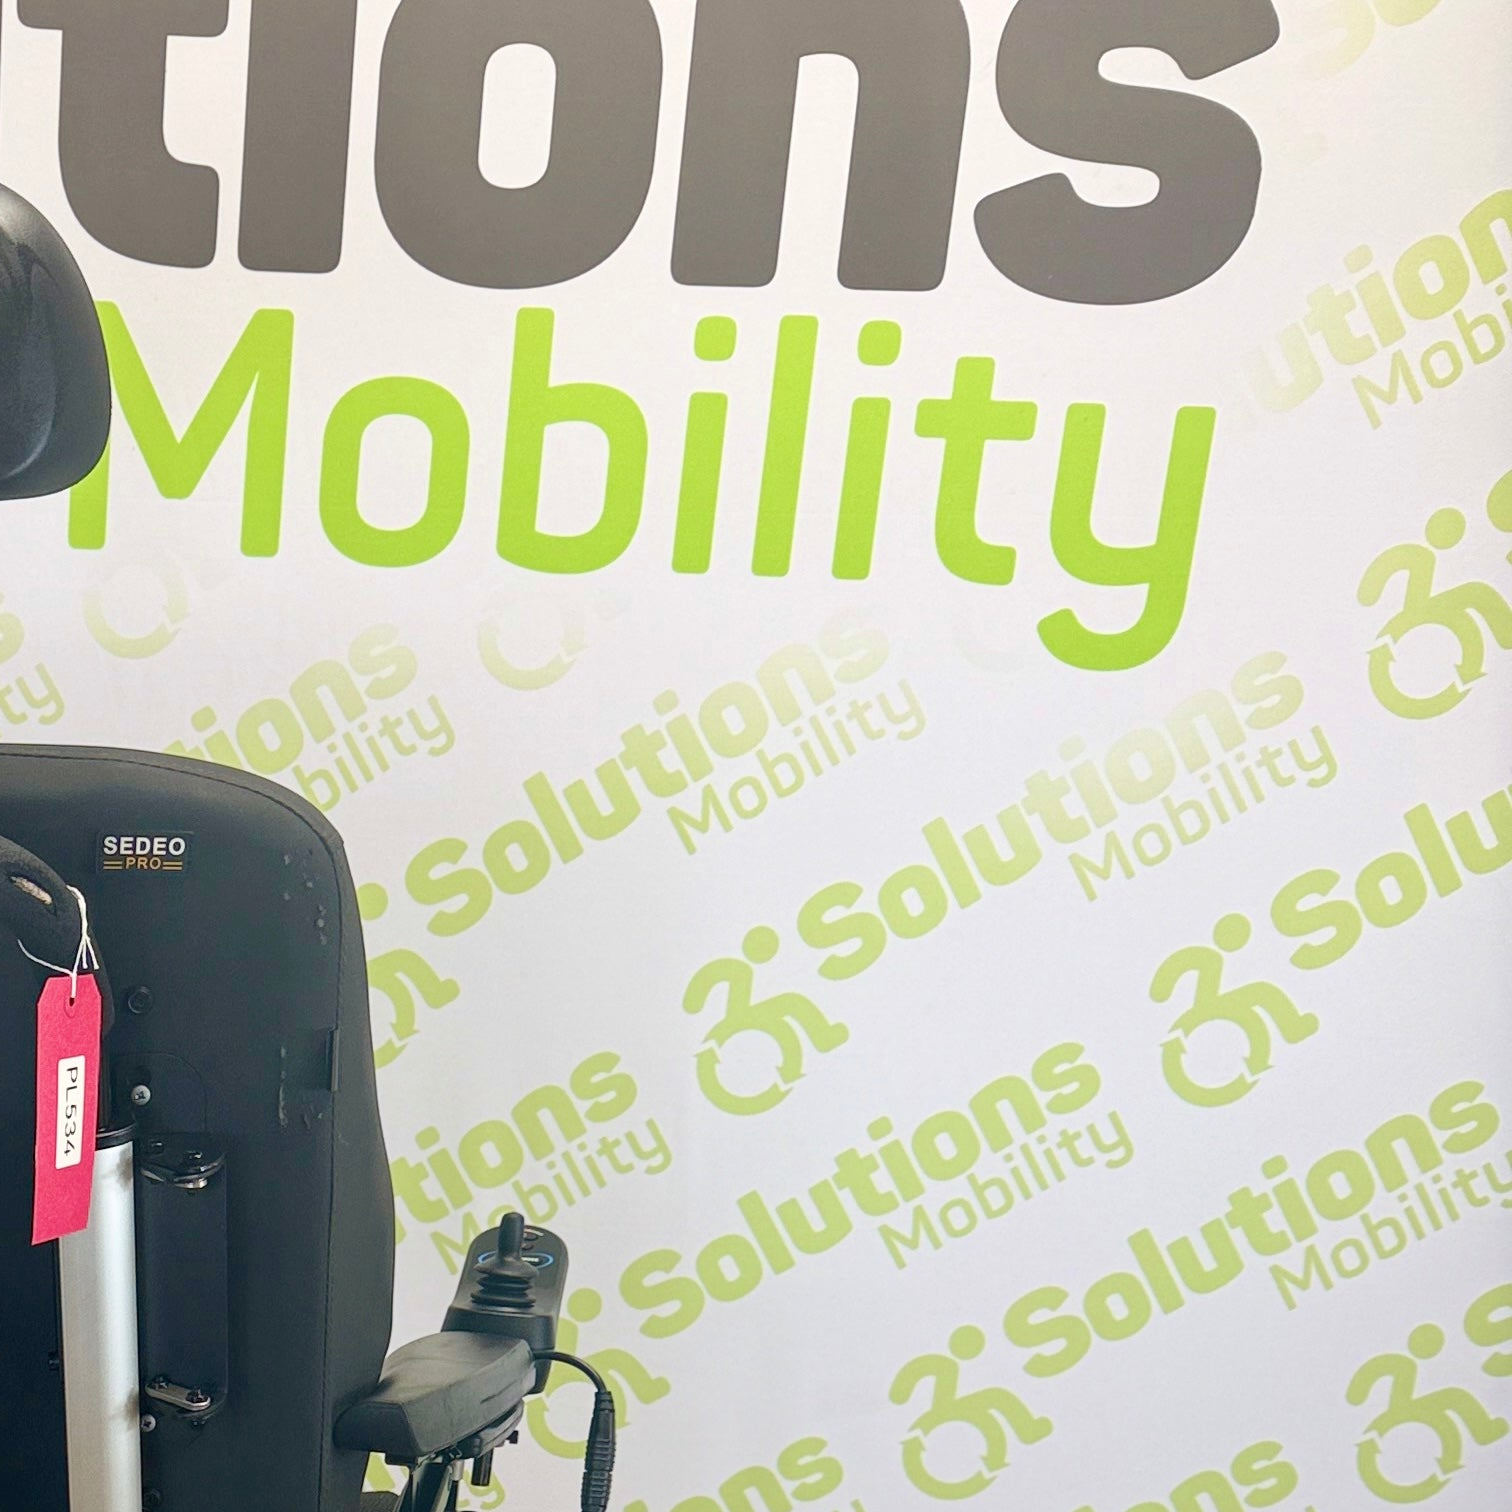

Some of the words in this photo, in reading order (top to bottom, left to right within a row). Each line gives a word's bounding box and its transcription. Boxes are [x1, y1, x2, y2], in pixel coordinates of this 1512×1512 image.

[67, 299, 1217, 672] Mobility
[292, 694, 456, 812] bility
[404, 609, 888, 938] Solutions
[666, 678, 926, 855] Mobility
[797, 650, 1305, 981] Solutions
[1068, 725, 1338, 901] Mobility
[103, 836, 186, 856] SEDEO
[125, 856, 162, 870] PRO
[63, 1066, 78, 1157] PL534
[392, 1051, 638, 1247] tions
[619, 1041, 1101, 1339] Solutions
[878, 1109, 1134, 1270] Mobility
[1003, 1080, 1500, 1378] Solutions
